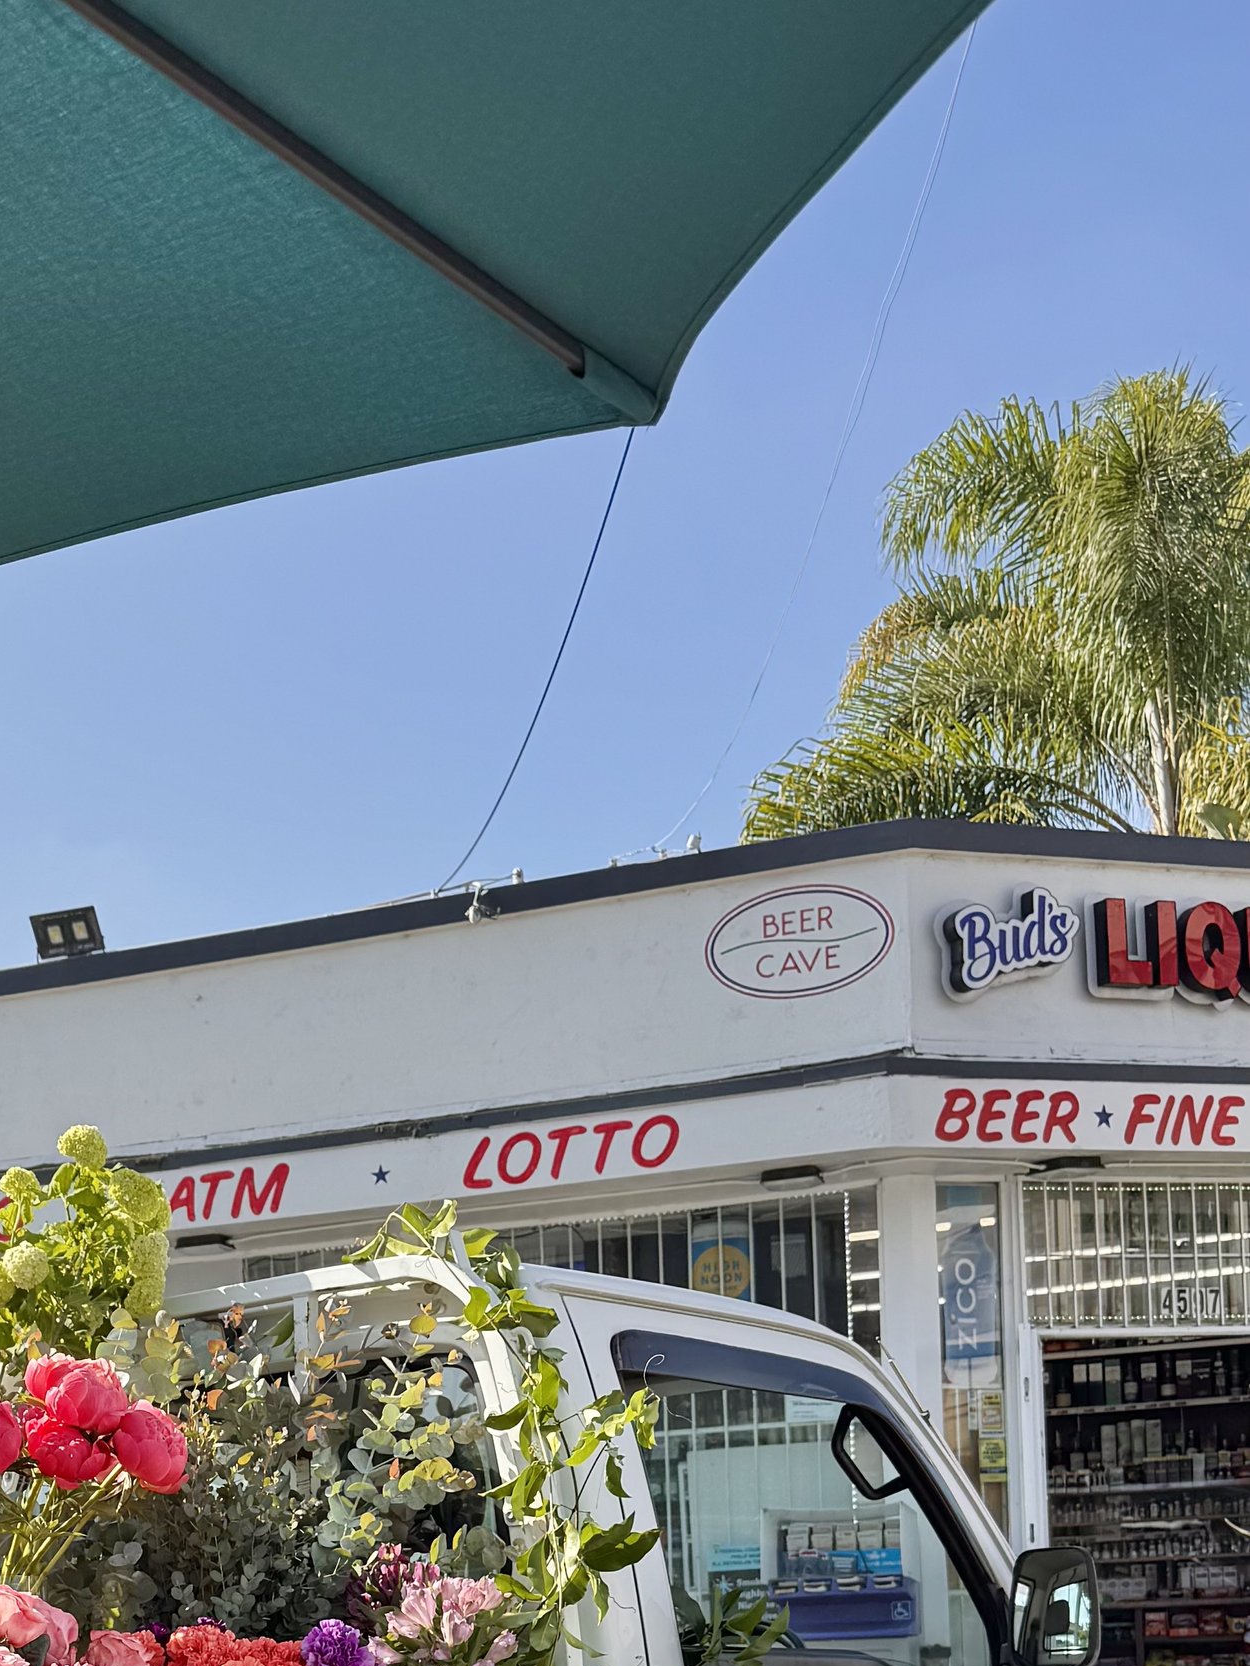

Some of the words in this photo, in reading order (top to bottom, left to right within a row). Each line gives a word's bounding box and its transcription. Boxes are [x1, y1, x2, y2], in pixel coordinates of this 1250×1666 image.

[762, 906, 833, 939] BEER
[960, 894, 1075, 982] Bud's
[1094, 897, 1250, 1000] LIQ
[756, 945, 841, 978] CAVE
[935, 1089, 1079, 1143] BEER
[1124, 1094, 1245, 1146] FINE
[170, 1163, 290, 1221] ATM
[463, 1114, 680, 1190] LOTTO
[950, 1258, 977, 1350] zico
